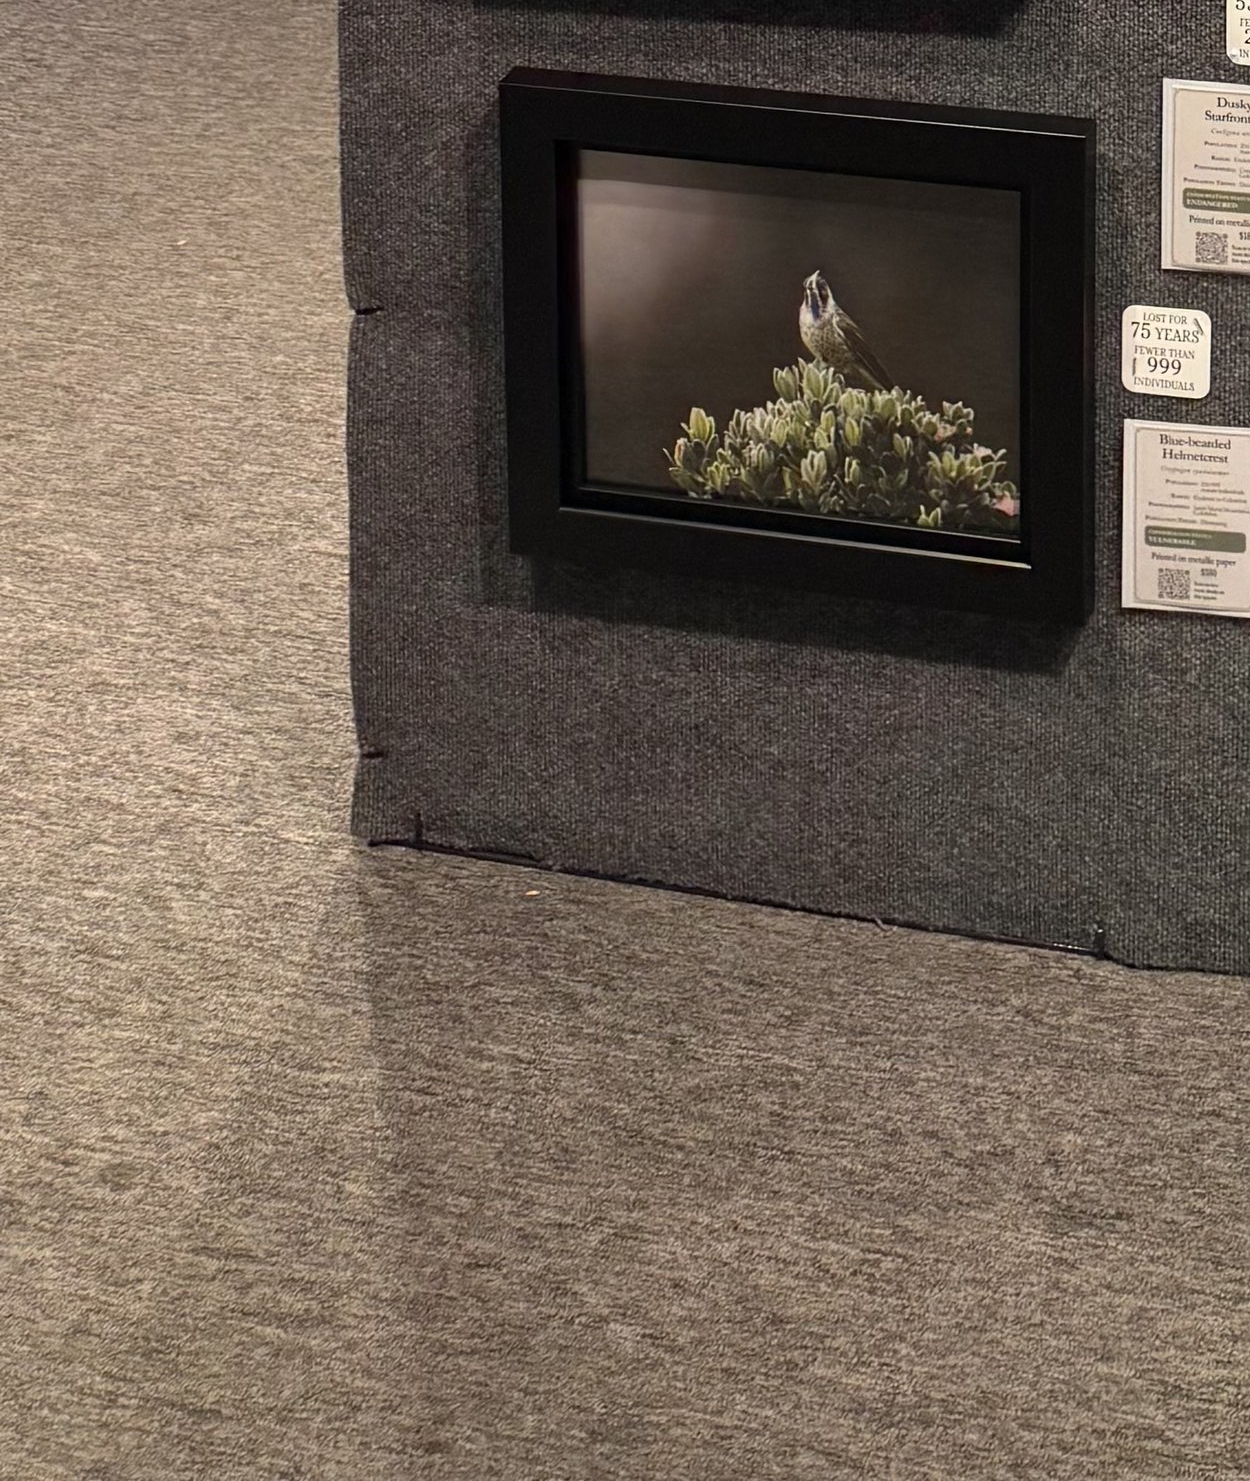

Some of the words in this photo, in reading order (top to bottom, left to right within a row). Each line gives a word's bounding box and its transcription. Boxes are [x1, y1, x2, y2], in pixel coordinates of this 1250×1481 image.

[1142, 311, 1166, 325] LOST
[1168, 314, 1187, 324] FOR
[1130, 321, 1150, 339] 75
[1155, 326, 1200, 343] YEARS
[1133, 344, 1167, 359] FEWER
[1168, 348, 1194, 360] THAN
[1147, 356, 1181, 375] 999
[1132, 375, 1194, 391] INDIVIDUALS
[1159, 433, 1231, 449] Blue-bearded
[1162, 448, 1227, 463] Helmetcrest
